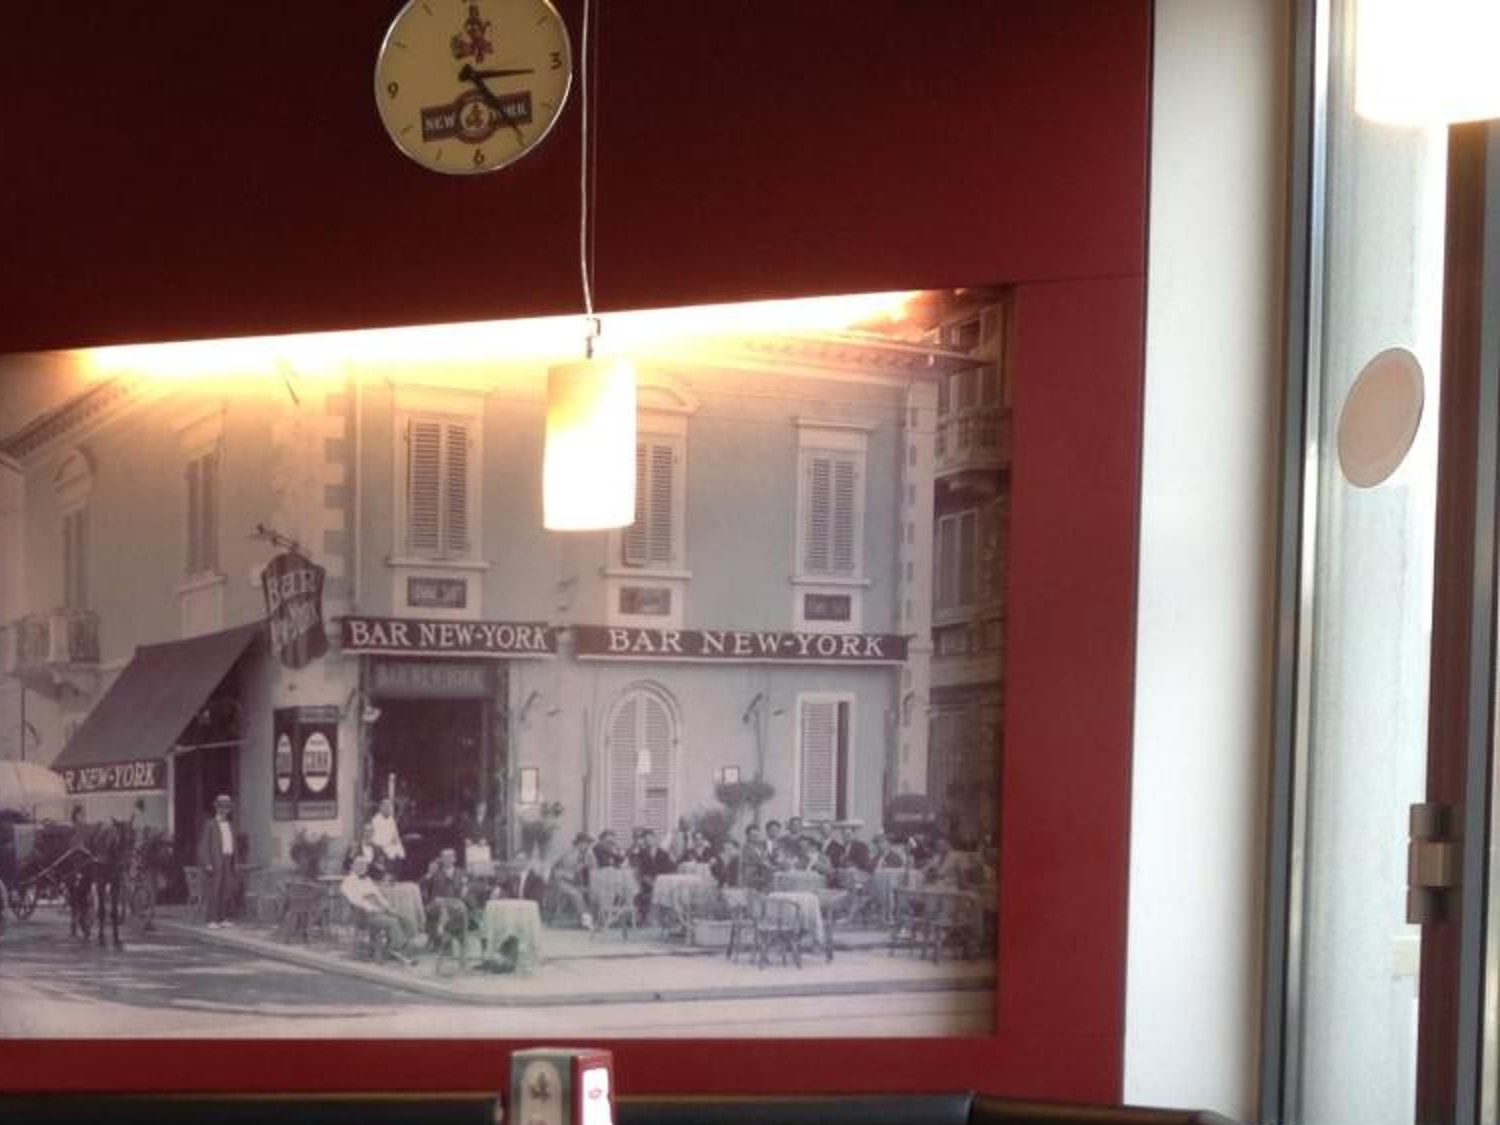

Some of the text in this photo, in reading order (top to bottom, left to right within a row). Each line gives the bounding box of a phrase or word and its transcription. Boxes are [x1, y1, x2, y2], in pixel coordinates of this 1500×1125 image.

[549, 51, 562, 70] 3
[387, 81, 399, 99] 9
[473, 148, 485, 166] 6
[350, 619, 413, 647] BAR
[418, 623, 548, 651] NEW-YORK
[608, 629, 885, 658] BAR NEW-YORK
